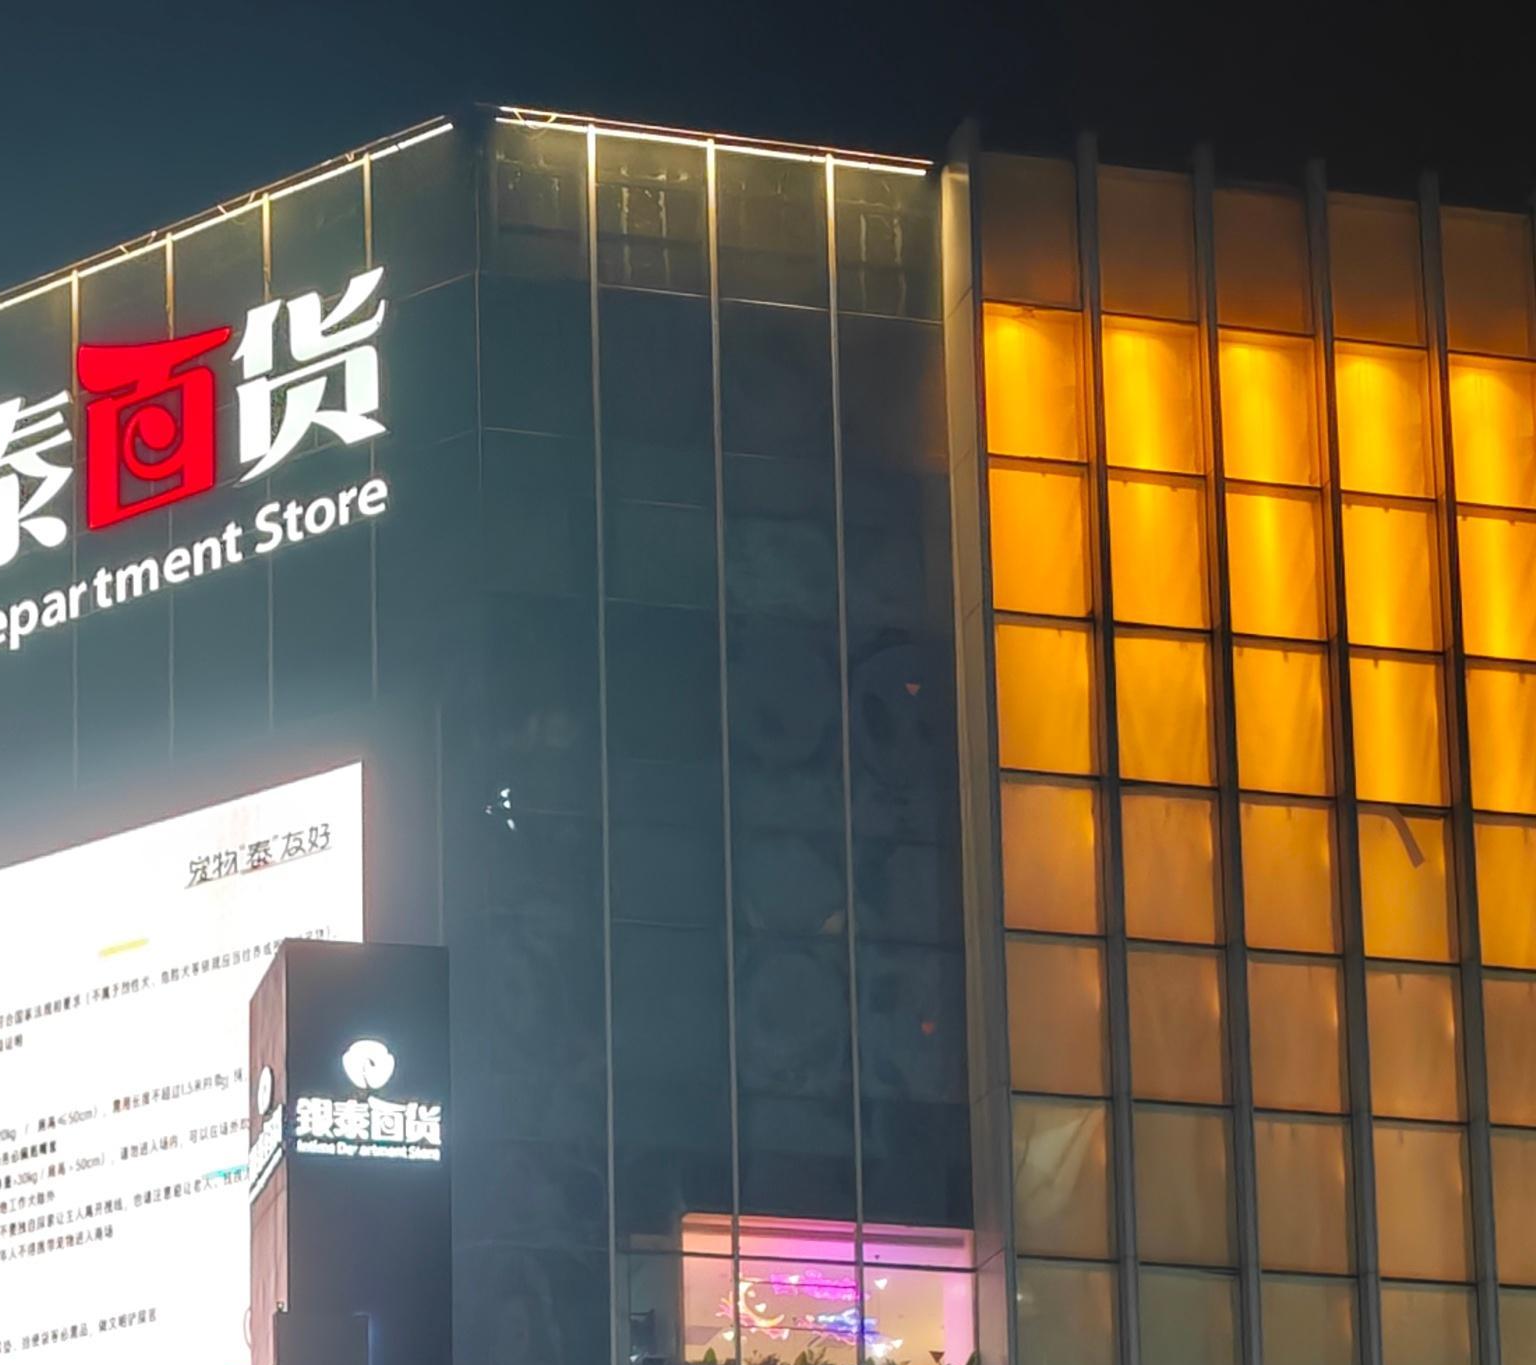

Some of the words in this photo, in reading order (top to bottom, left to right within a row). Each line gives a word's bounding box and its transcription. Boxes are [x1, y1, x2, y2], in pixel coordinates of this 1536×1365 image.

[255, 476, 389, 555] Store
[296, 1096, 442, 1146] 银泰百货
